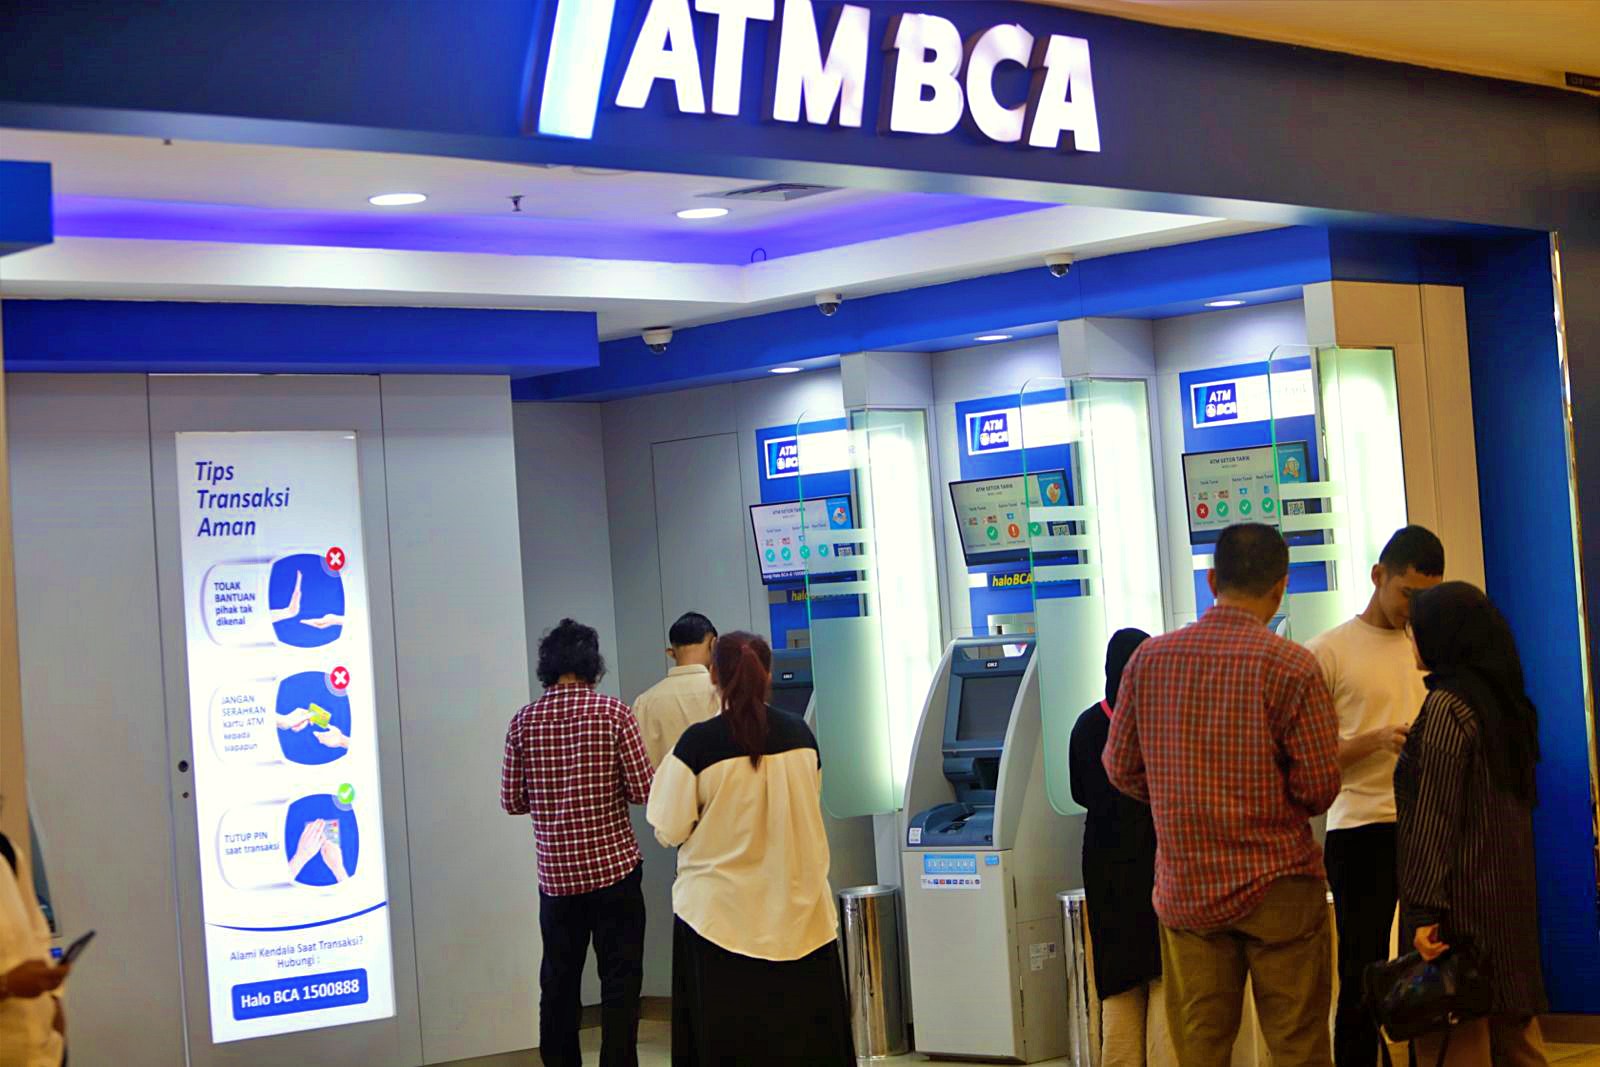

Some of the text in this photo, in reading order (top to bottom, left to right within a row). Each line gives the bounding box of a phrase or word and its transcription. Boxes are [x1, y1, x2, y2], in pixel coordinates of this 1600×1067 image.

[615, 0, 1101, 153] ATM BCA
[1209, 389, 1232, 403] ATM
[983, 418, 1004, 432] ATM
[195, 461, 234, 485] Tips
[197, 486, 290, 509] Transaksi
[197, 517, 256, 537] Aman
[214, 581, 241, 591] TOLAK
[215, 593, 256, 603] BANTUAN
[215, 603, 253, 615] pihak tak
[216, 616, 246, 627] dikenal
[224, 831, 268, 843] TUTUP PIN
[224, 840, 280, 856] saat transaksi
[230, 935, 364, 961] Alami Kendala Saat Transaksi?
[277, 956, 315, 968] Hubungi
[240, 979, 360, 1008] Halo BCA 1500888
